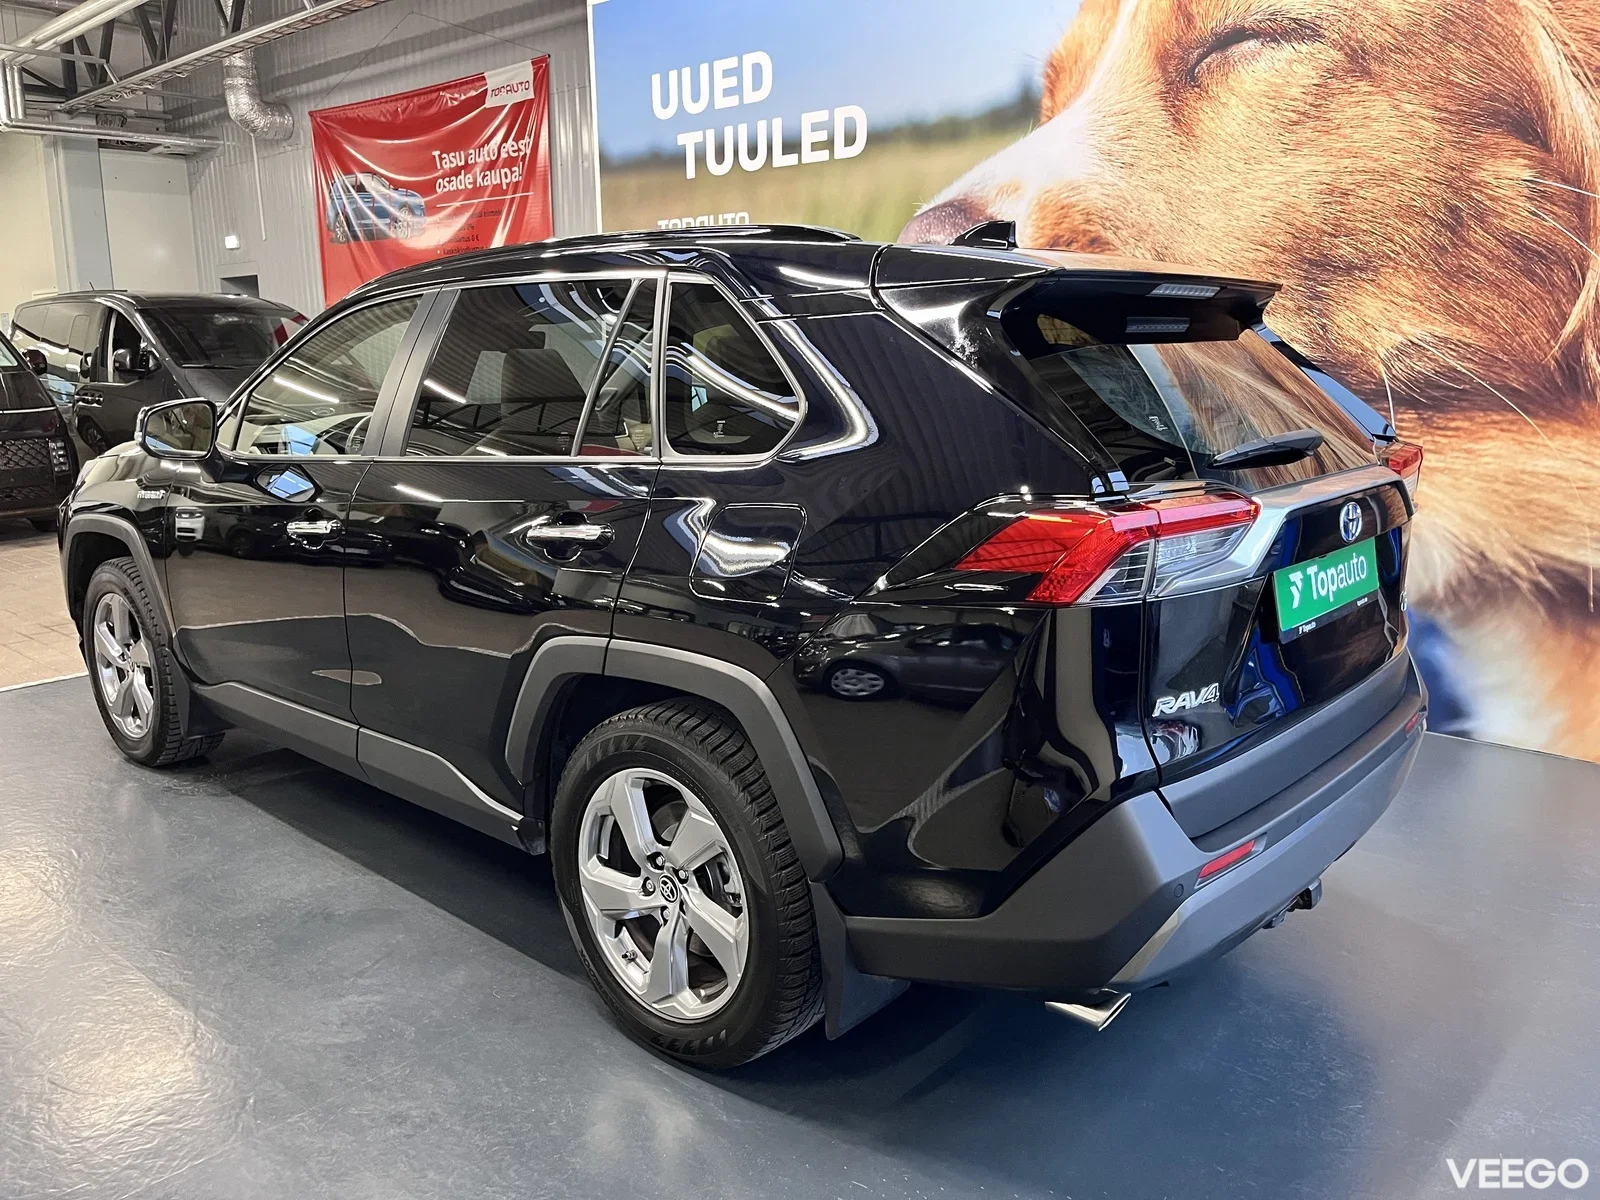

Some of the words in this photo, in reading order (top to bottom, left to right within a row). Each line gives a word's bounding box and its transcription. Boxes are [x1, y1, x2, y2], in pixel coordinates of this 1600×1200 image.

[651, 50, 773, 121] UUED
[432, 149, 465, 170] Tasu
[468, 144, 498, 163] auto
[500, 136, 532, 157] eest
[676, 104, 868, 180] TUULED
[435, 172, 474, 194] osade
[476, 162, 523, 191] kaupa!
[1306, 553, 1368, 602] Topauto
[1152, 682, 1220, 718] RAV4
